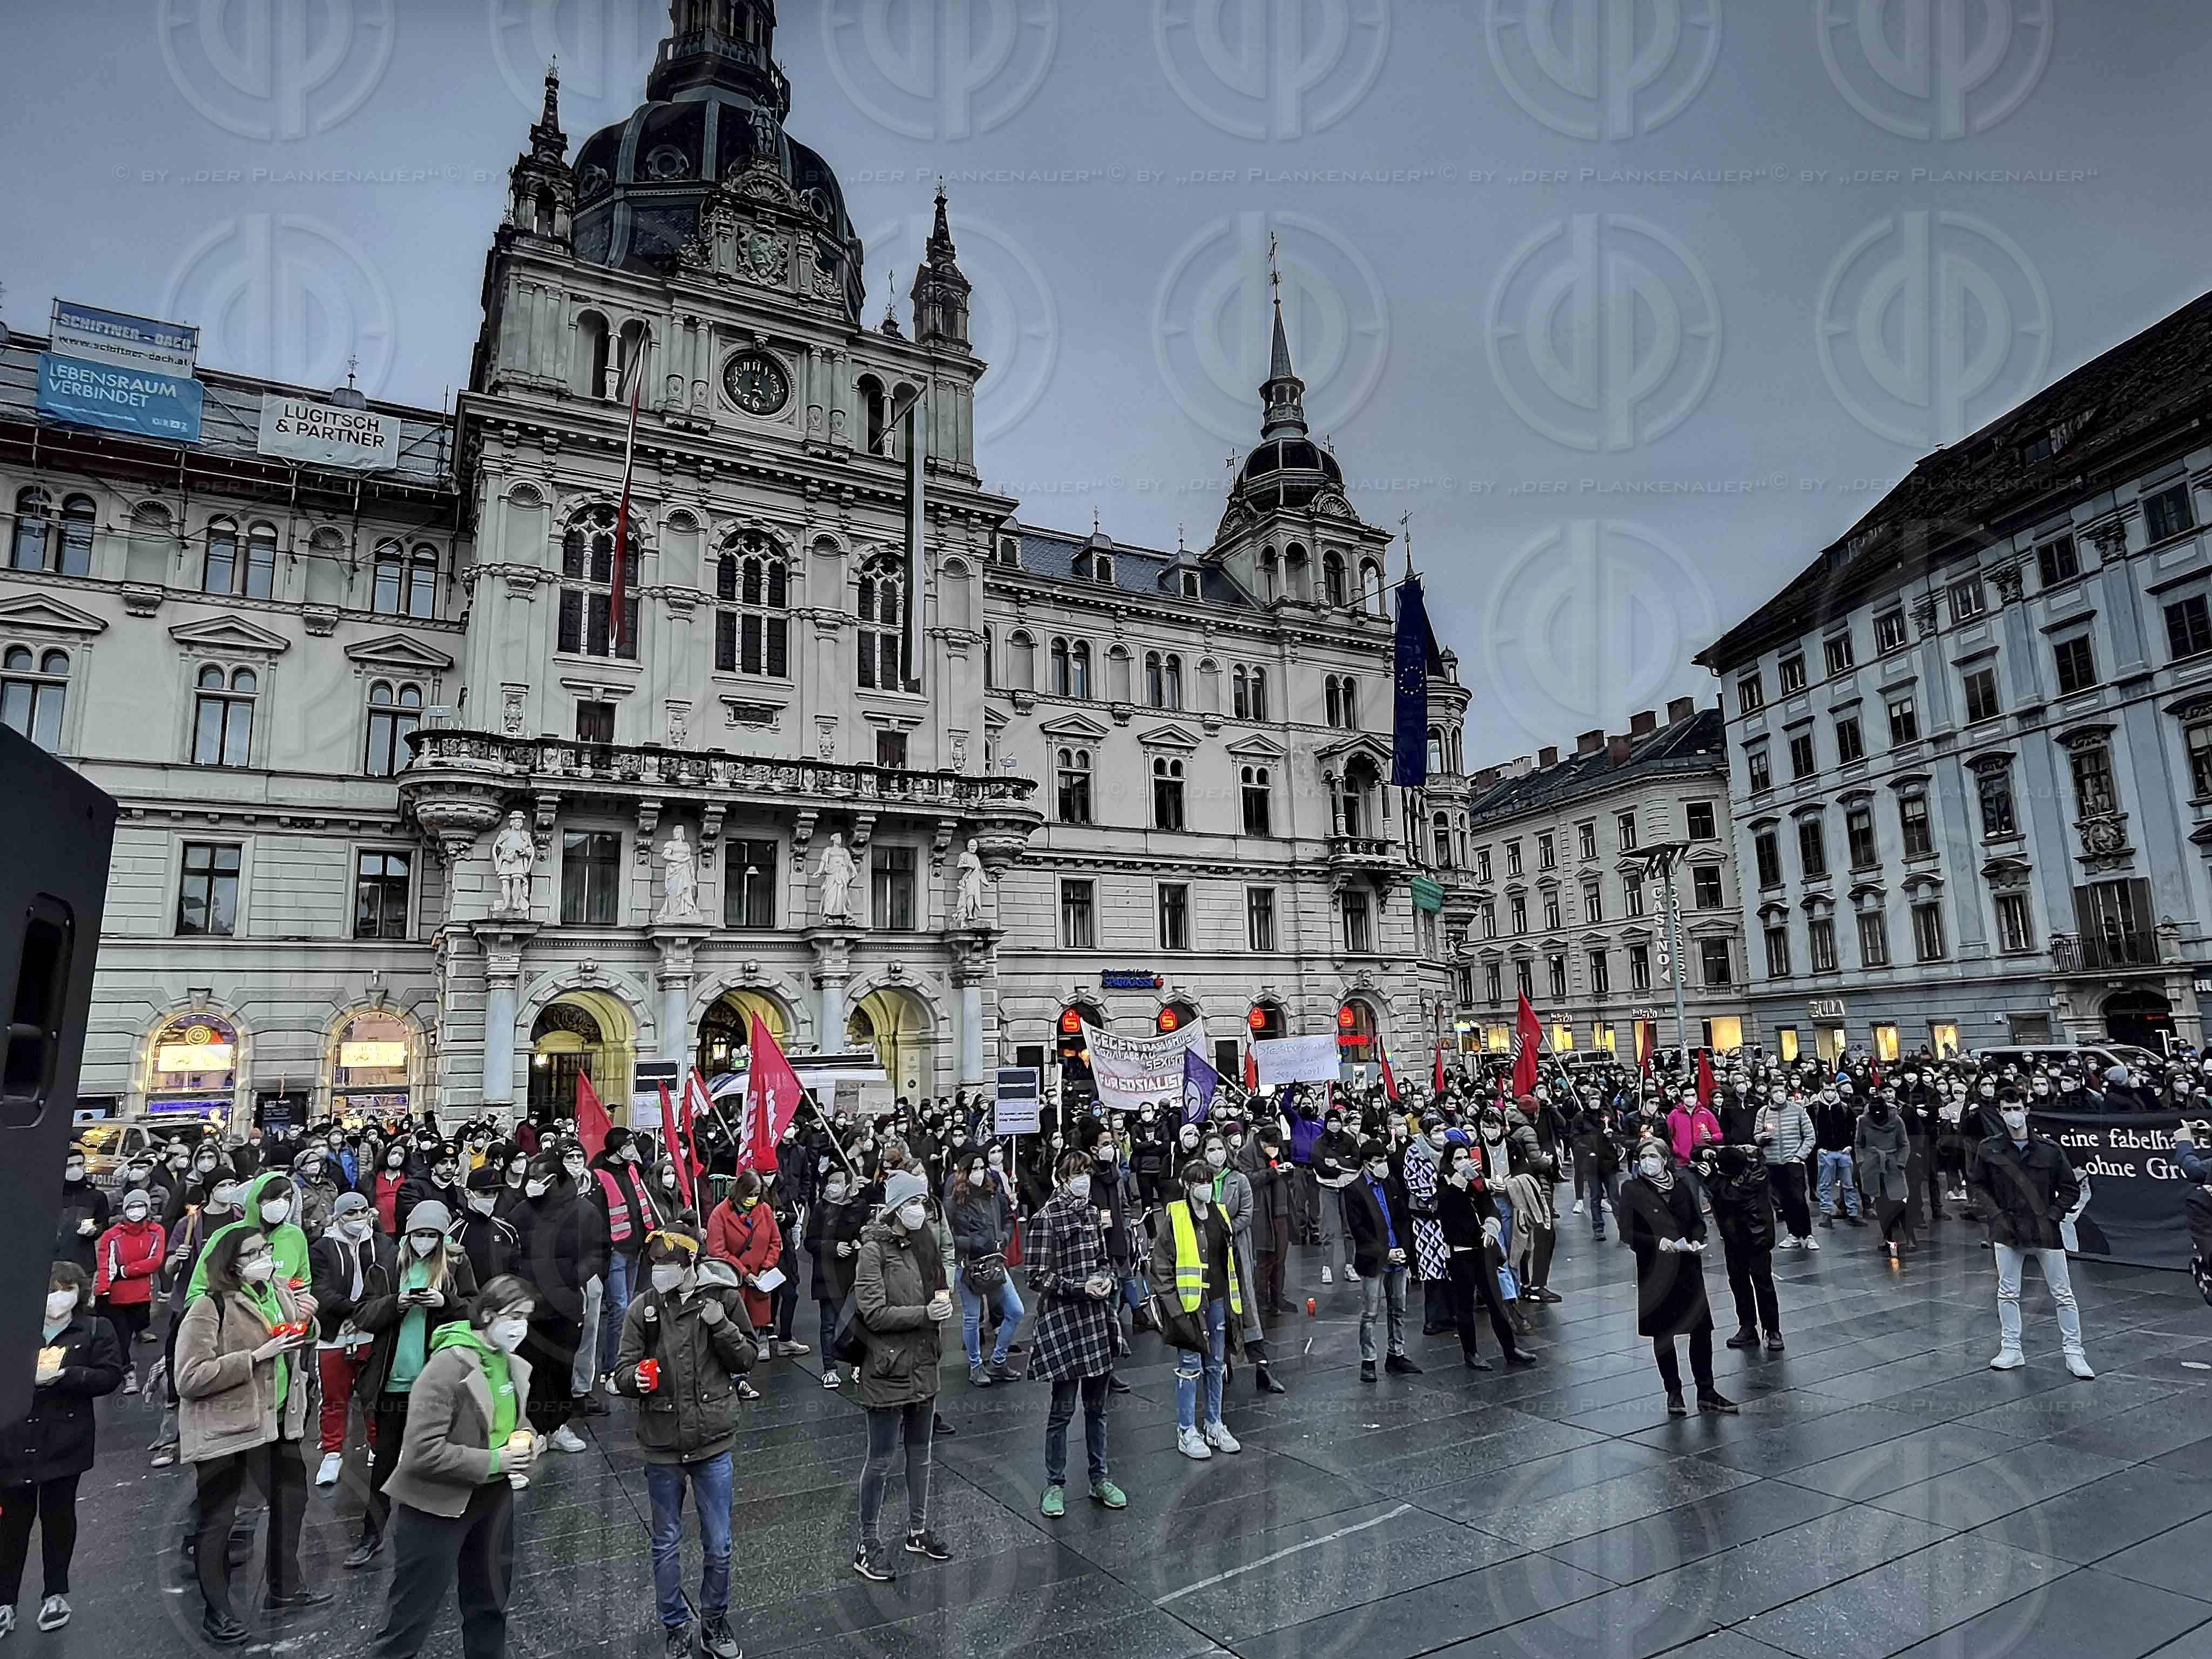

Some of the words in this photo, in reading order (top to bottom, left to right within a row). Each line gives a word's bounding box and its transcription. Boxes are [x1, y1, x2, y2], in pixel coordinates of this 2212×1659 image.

[48, 377, 151, 407] VERBINDET
[49, 362, 177, 398] LEBENSRAUM
[285, 404, 379, 433] LUGITSCH
[276, 419, 290, 433] &
[296, 422, 385, 448] PARTNER
[1651, 887, 1670, 965] CASINO
[2060, 1128, 2099, 1147] eine
[2086, 1155, 2136, 1177] ohne
